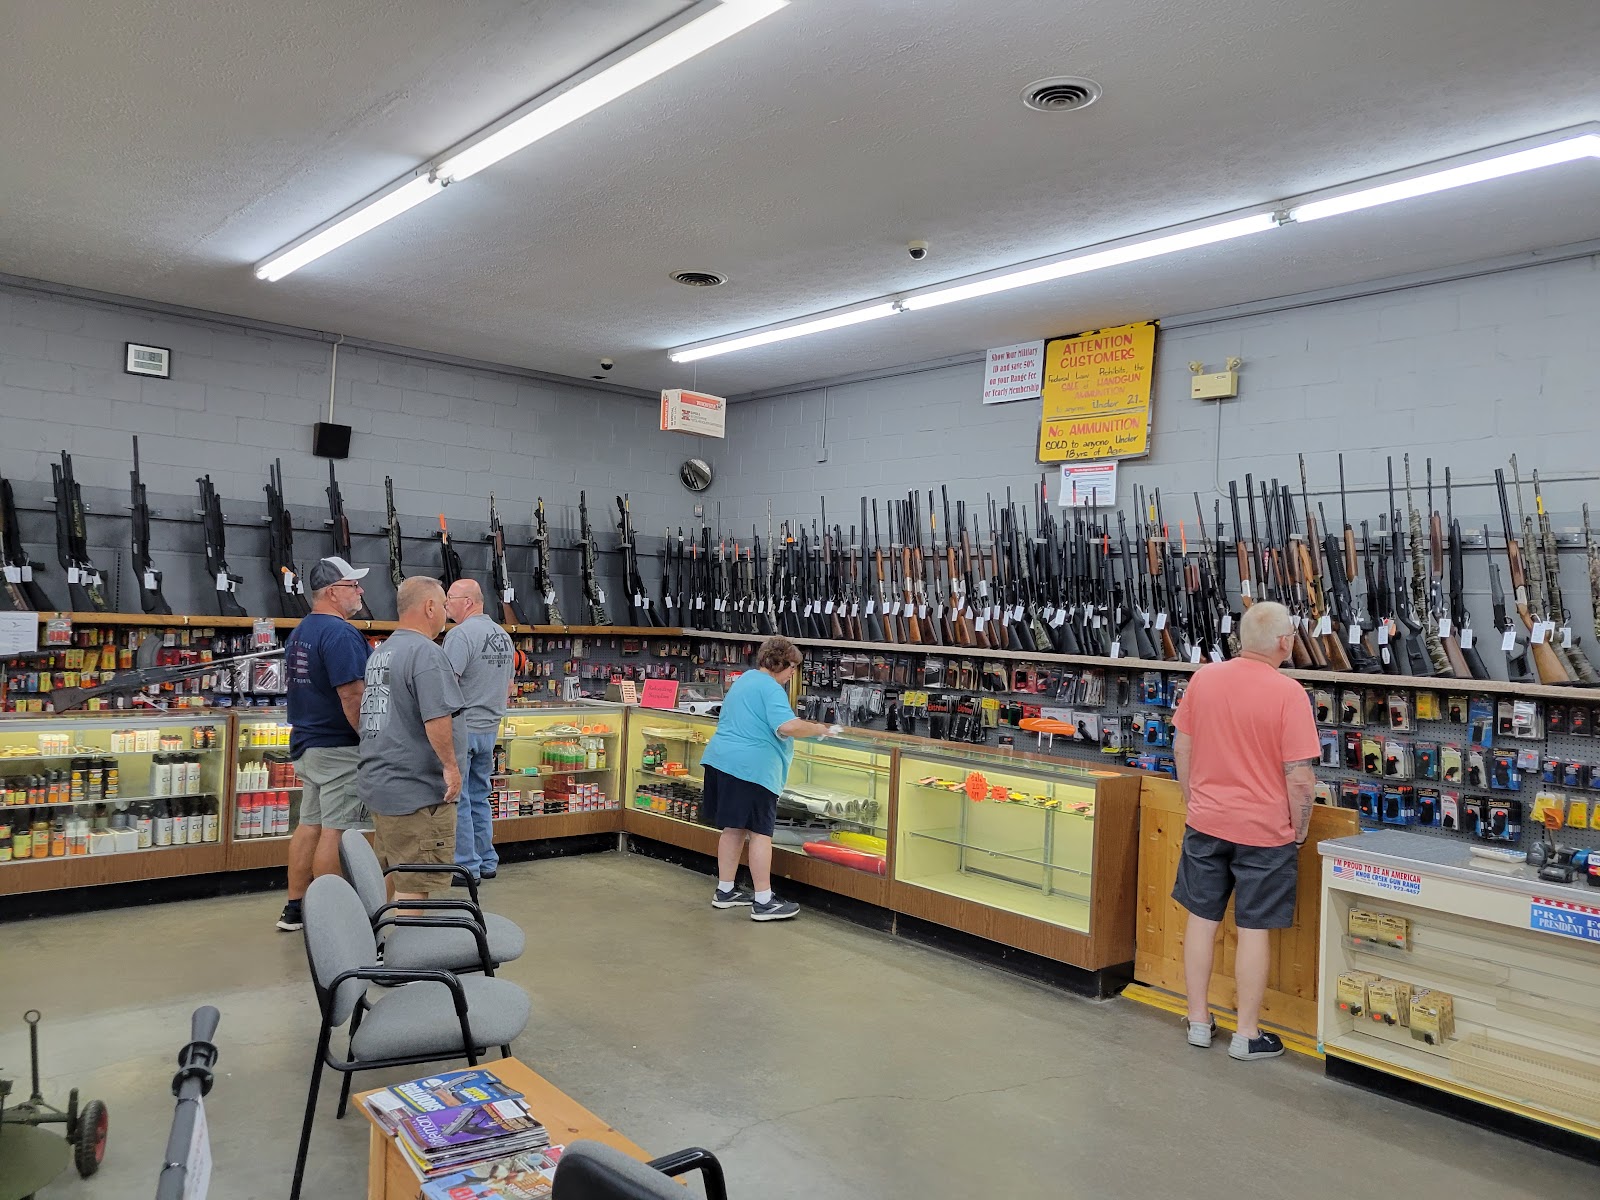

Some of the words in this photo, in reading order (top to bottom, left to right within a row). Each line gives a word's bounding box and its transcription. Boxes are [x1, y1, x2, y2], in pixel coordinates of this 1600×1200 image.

[1063, 334, 1133, 355] ATTENTION
[992, 353, 1004, 361] Show
[1018, 348, 1038, 357] Military
[1060, 348, 1135, 368] CUSTOMERS
[993, 365, 998, 373] ID
[1000, 364, 1009, 372] and
[998, 376, 1009, 385] your
[1011, 373, 1026, 382] Range
[1028, 372, 1036, 380] Fee
[1048, 373, 1069, 382] Federal
[1062, 381, 1079, 392] SALE
[1097, 373, 1140, 387] HANDGUN
[992, 388, 1007, 396] Yearly
[1009, 383, 1039, 394] Membership
[1075, 386, 1125, 399] AMMUNITION
[1092, 400, 1119, 409] Under
[1069, 418, 1139, 436] AMMUNITION
[1046, 441, 1067, 450] SOLD
[1083, 440, 1109, 449] anyone
[1116, 434, 1138, 444] Under
[1094, 447, 1100, 456] of
[1334, 858, 1342, 866] I'M
[1344, 860, 1362, 871] PROUD
[1391, 871, 1421, 883] AMERICAN
[1372, 874, 1387, 882] CREEK
[1402, 880, 1420, 890] RANGE
[1533, 909, 1576, 924] PRAY
[1540, 918, 1584, 935] PRESIDENT
